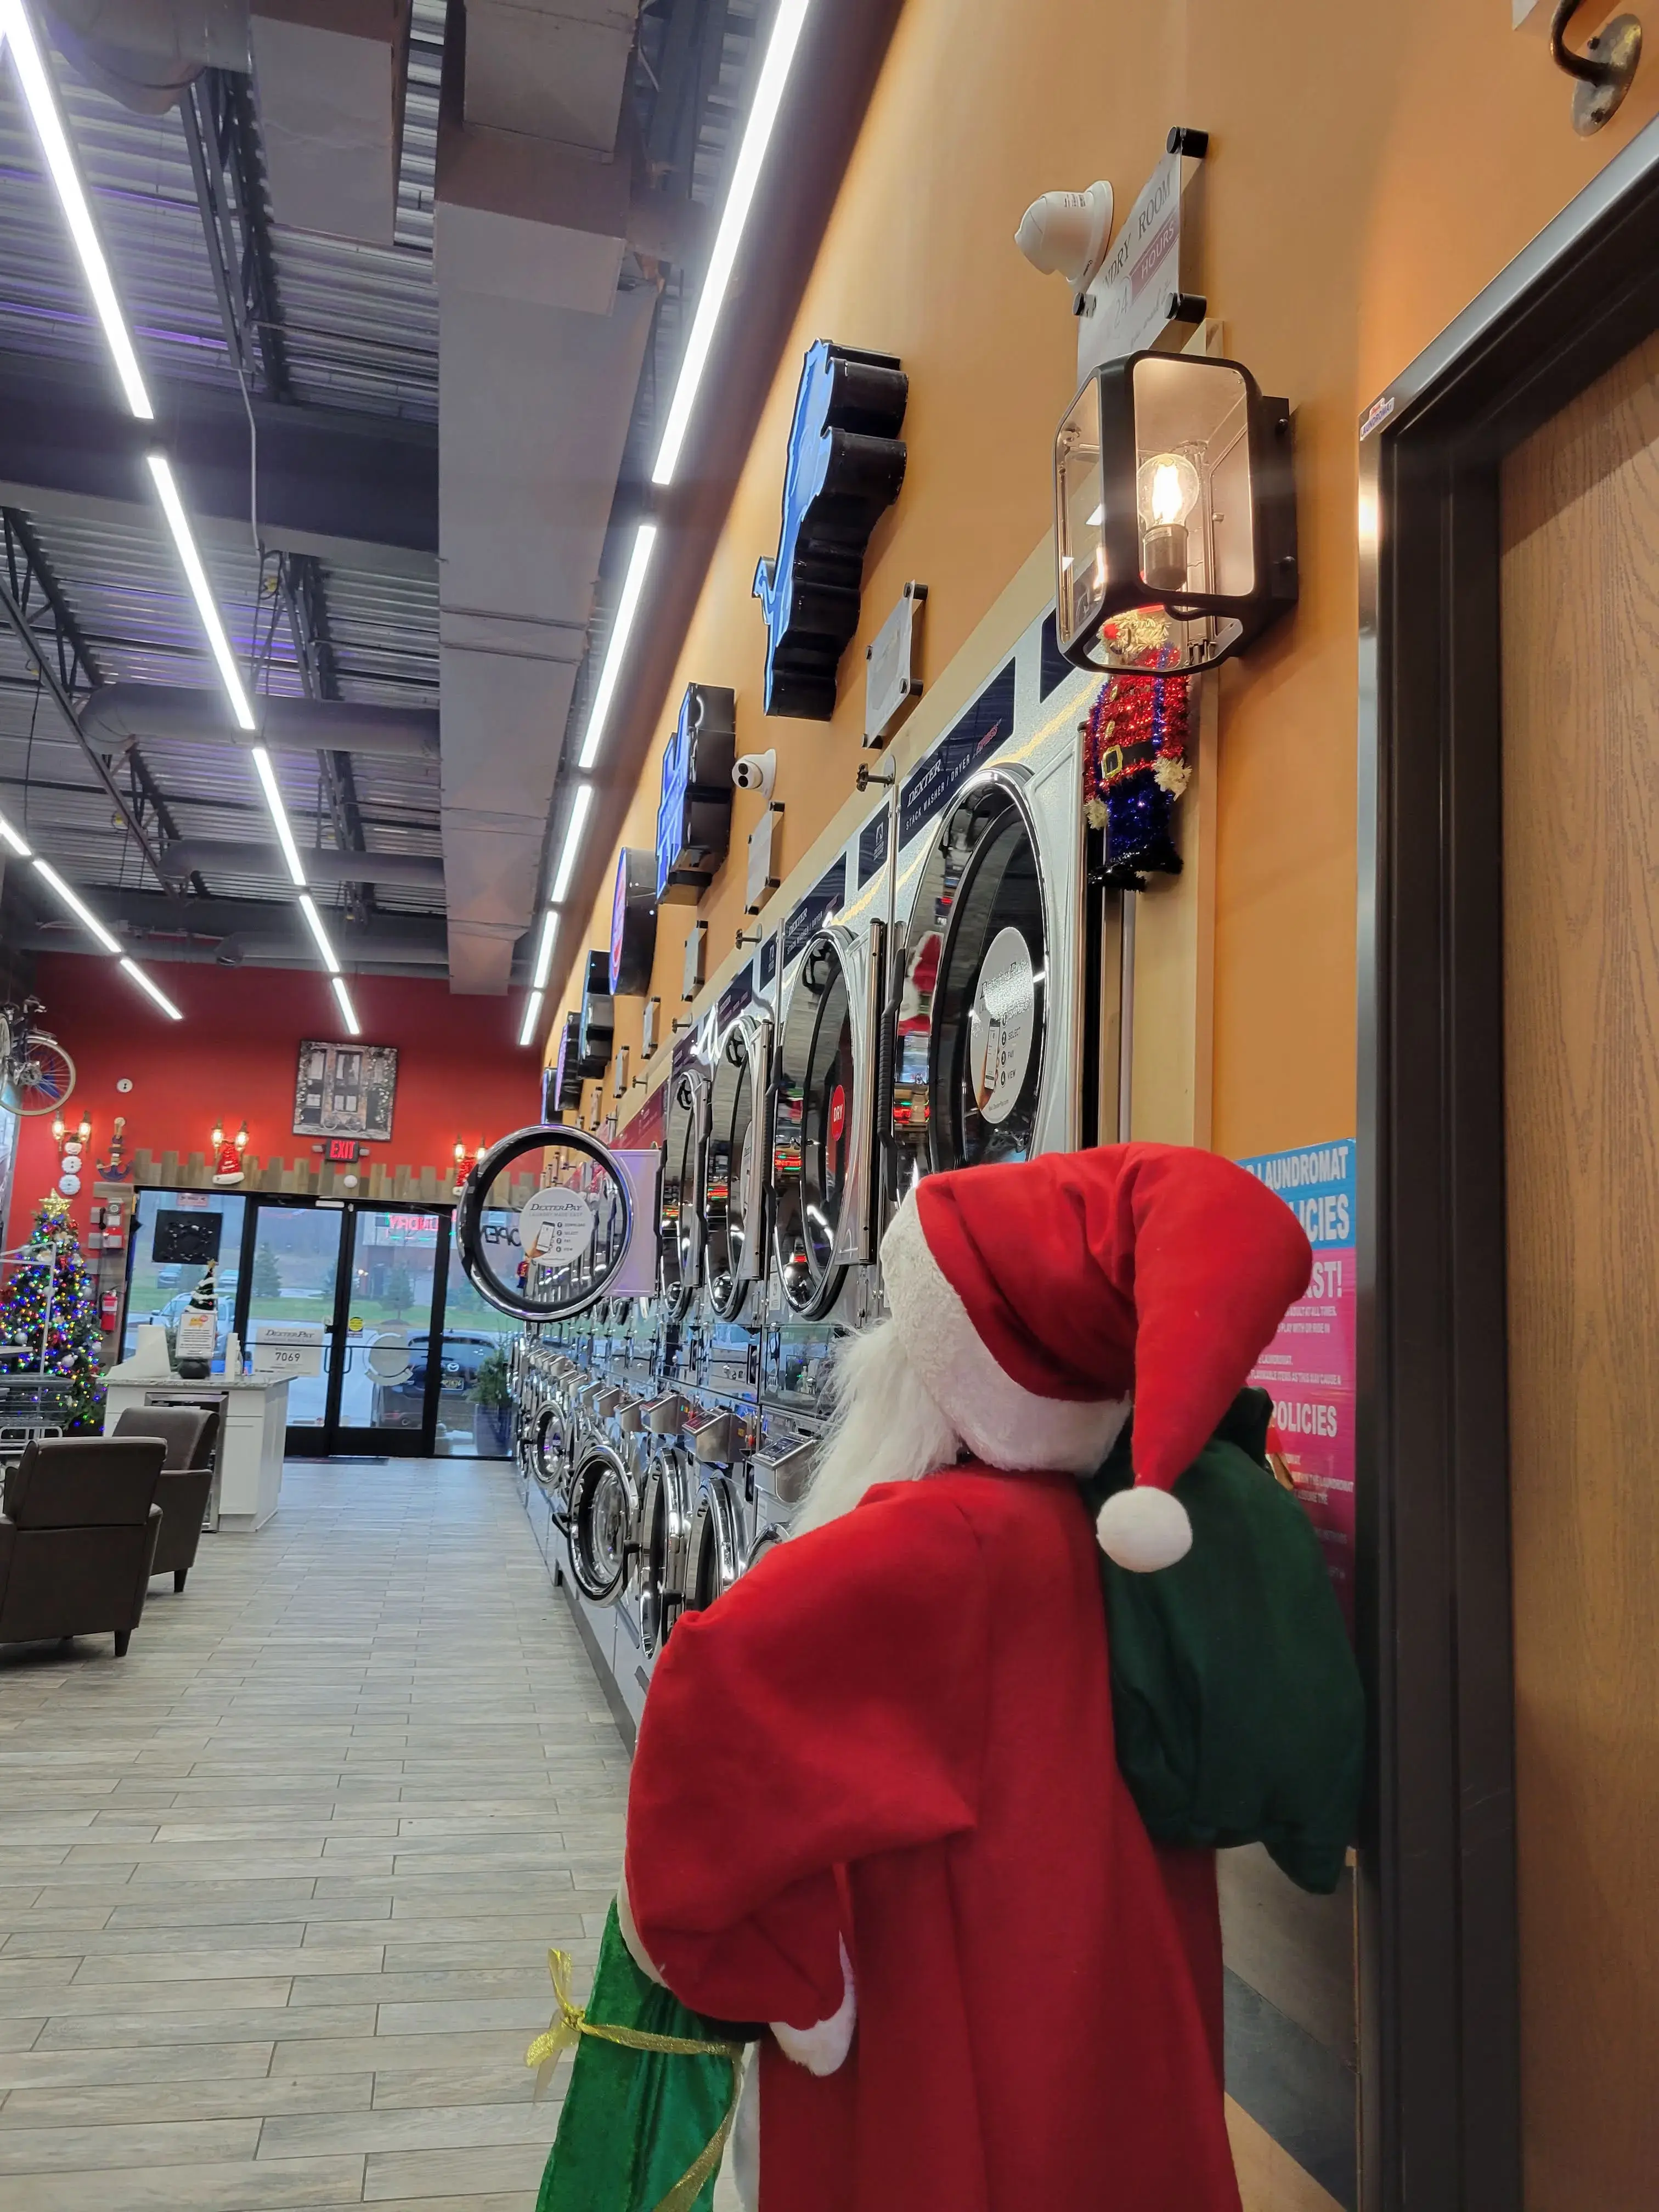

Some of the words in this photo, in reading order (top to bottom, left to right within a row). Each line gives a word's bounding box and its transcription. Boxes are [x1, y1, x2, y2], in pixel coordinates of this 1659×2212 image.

[1103, 233, 1131, 290] NDRY
[1137, 171, 1173, 240] ROOM
[1141, 221, 1175, 279] HOURS
[906, 806, 922, 831] STACK
[923, 783, 945, 812] WASHER
[951, 754, 970, 782] DRYER
[907, 759, 941, 808] DEXTER
[1008, 1027, 1021, 1041] SELECT
[834, 1104, 843, 1122] DRY
[330, 1140, 356, 1159] EXIT
[275, 1352, 301, 1362] 7069
